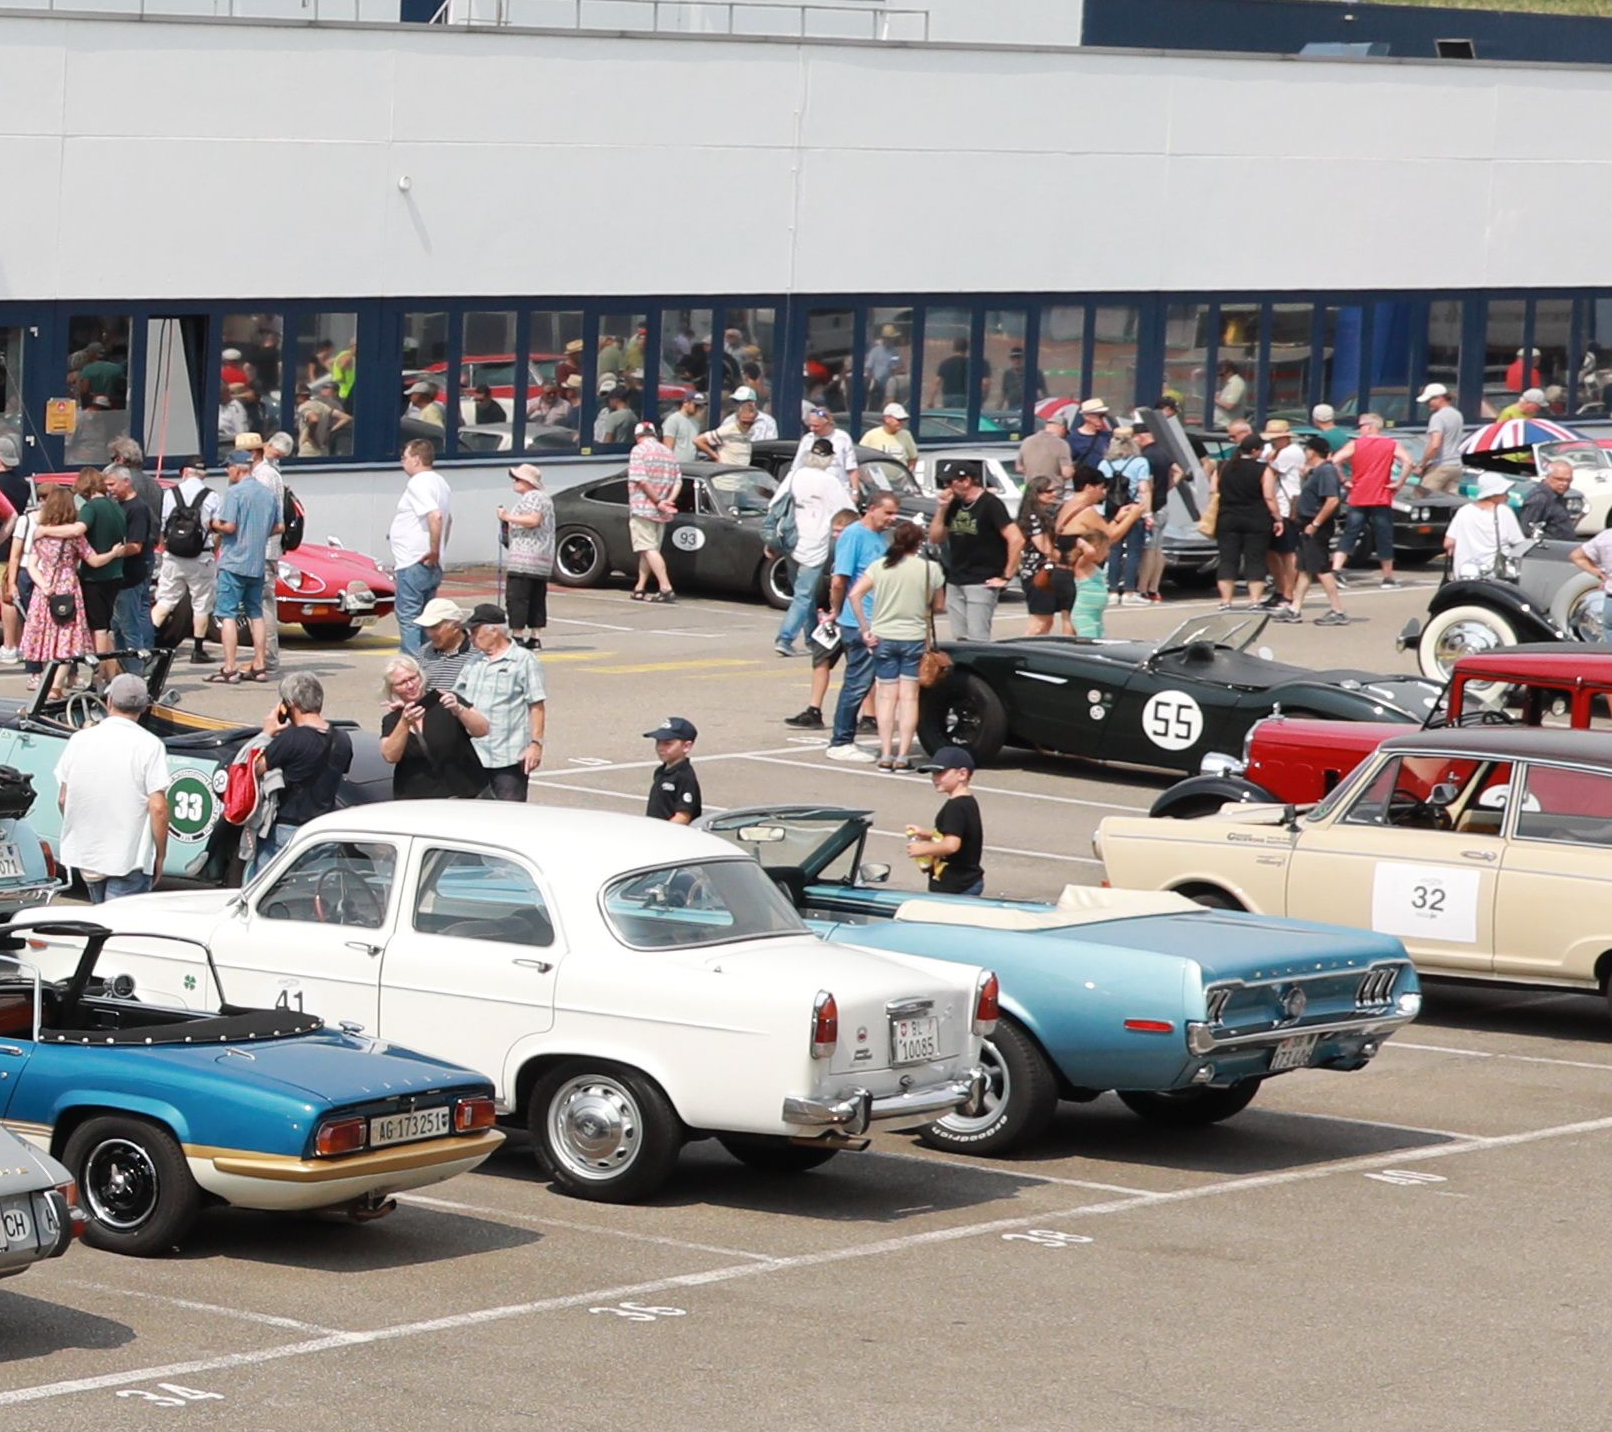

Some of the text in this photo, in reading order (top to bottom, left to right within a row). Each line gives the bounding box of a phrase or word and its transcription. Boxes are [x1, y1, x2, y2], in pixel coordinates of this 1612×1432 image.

[680, 531, 697, 546] 93
[1153, 700, 1193, 741] 55
[174, 791, 203, 822] 33
[1411, 886, 1446, 912] 32
[275, 989, 303, 1012] 41
[911, 1021, 923, 1036] BL
[902, 1036, 934, 1060] 10085
[1363, 1169, 1449, 1186] 40
[4, 1214, 26, 1237] CH
[1001, 1229, 1094, 1247] 38
[589, 1300, 687, 1321] 36
[115, 1382, 225, 1407] 34
